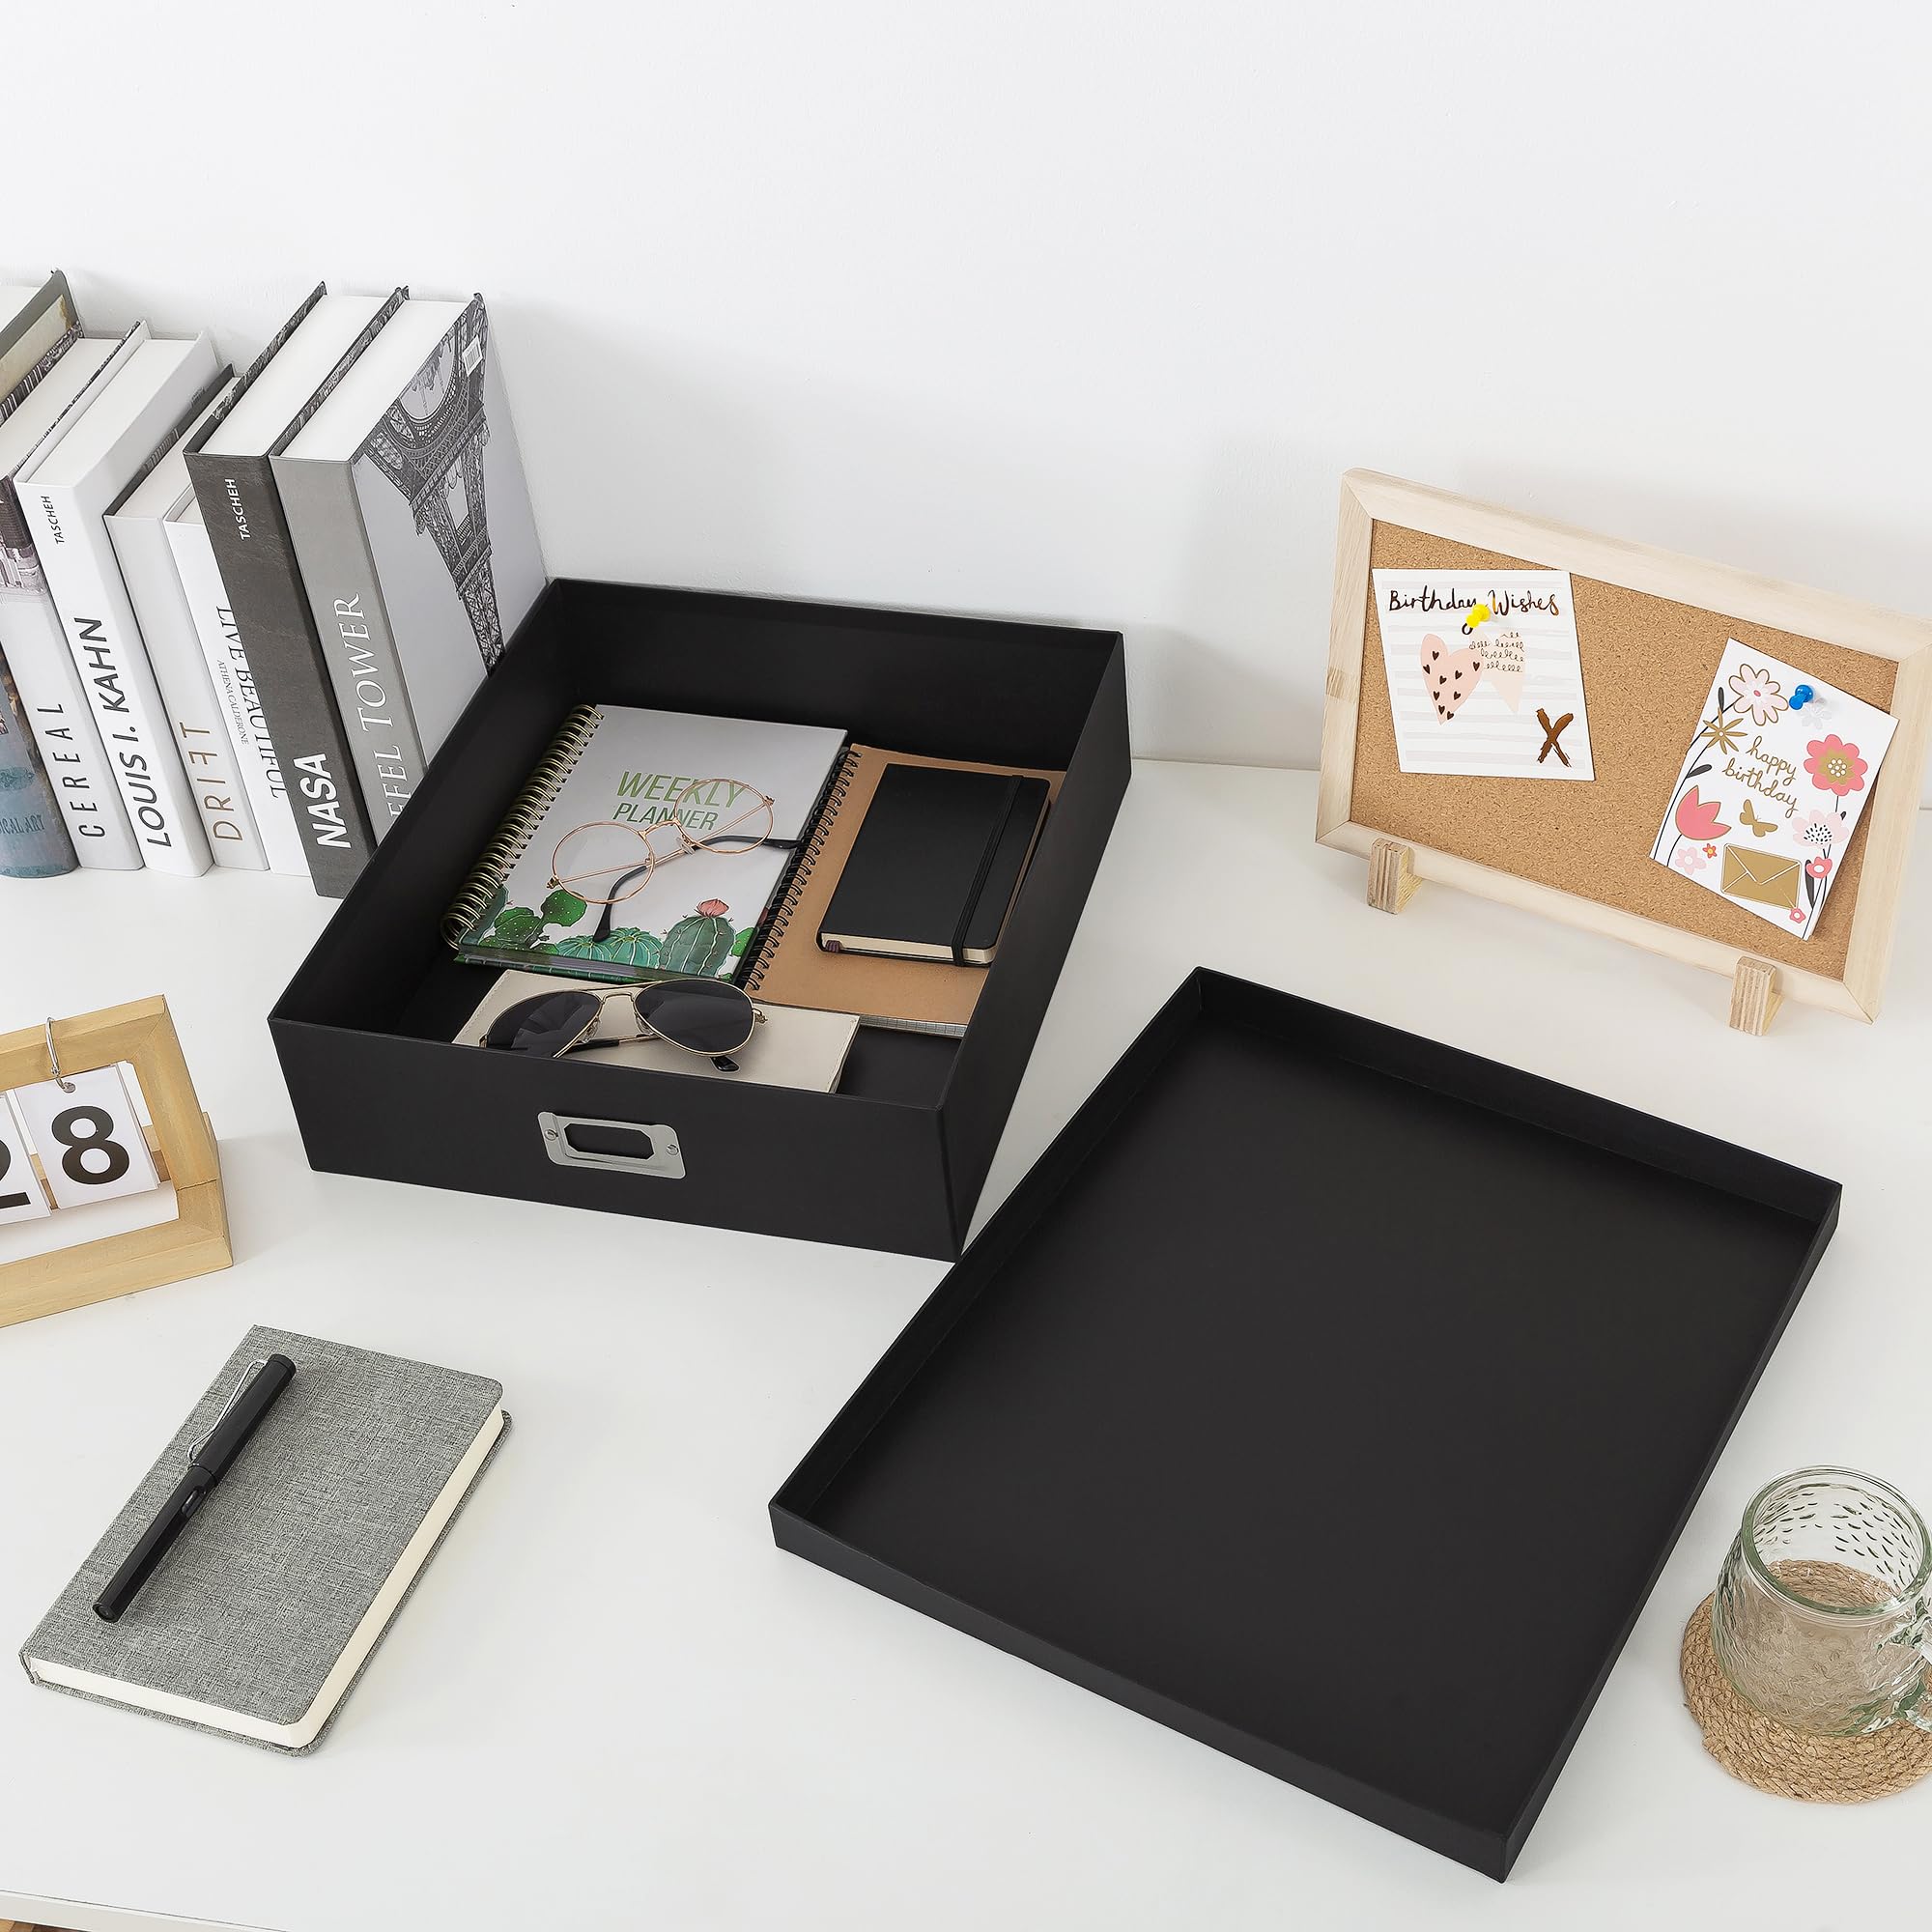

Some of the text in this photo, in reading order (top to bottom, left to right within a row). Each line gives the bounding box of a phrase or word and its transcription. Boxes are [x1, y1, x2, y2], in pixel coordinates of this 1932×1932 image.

[215, 606, 245, 661] LIVE
[1488, 589, 1560, 616] Wishes
[333, 593, 393, 732] TOWER
[73, 617, 172, 848] LOUIS I. KAHN
[1745, 735, 1797, 787] happy
[37, 703, 106, 838] CEREAL
[179, 722, 243, 841] DRIFT
[293, 753, 352, 849] NASA
[616, 771, 747, 809] WEEKLY
[1721, 756, 1799, 819] birthday
[612, 802, 719, 831] PLANNER
